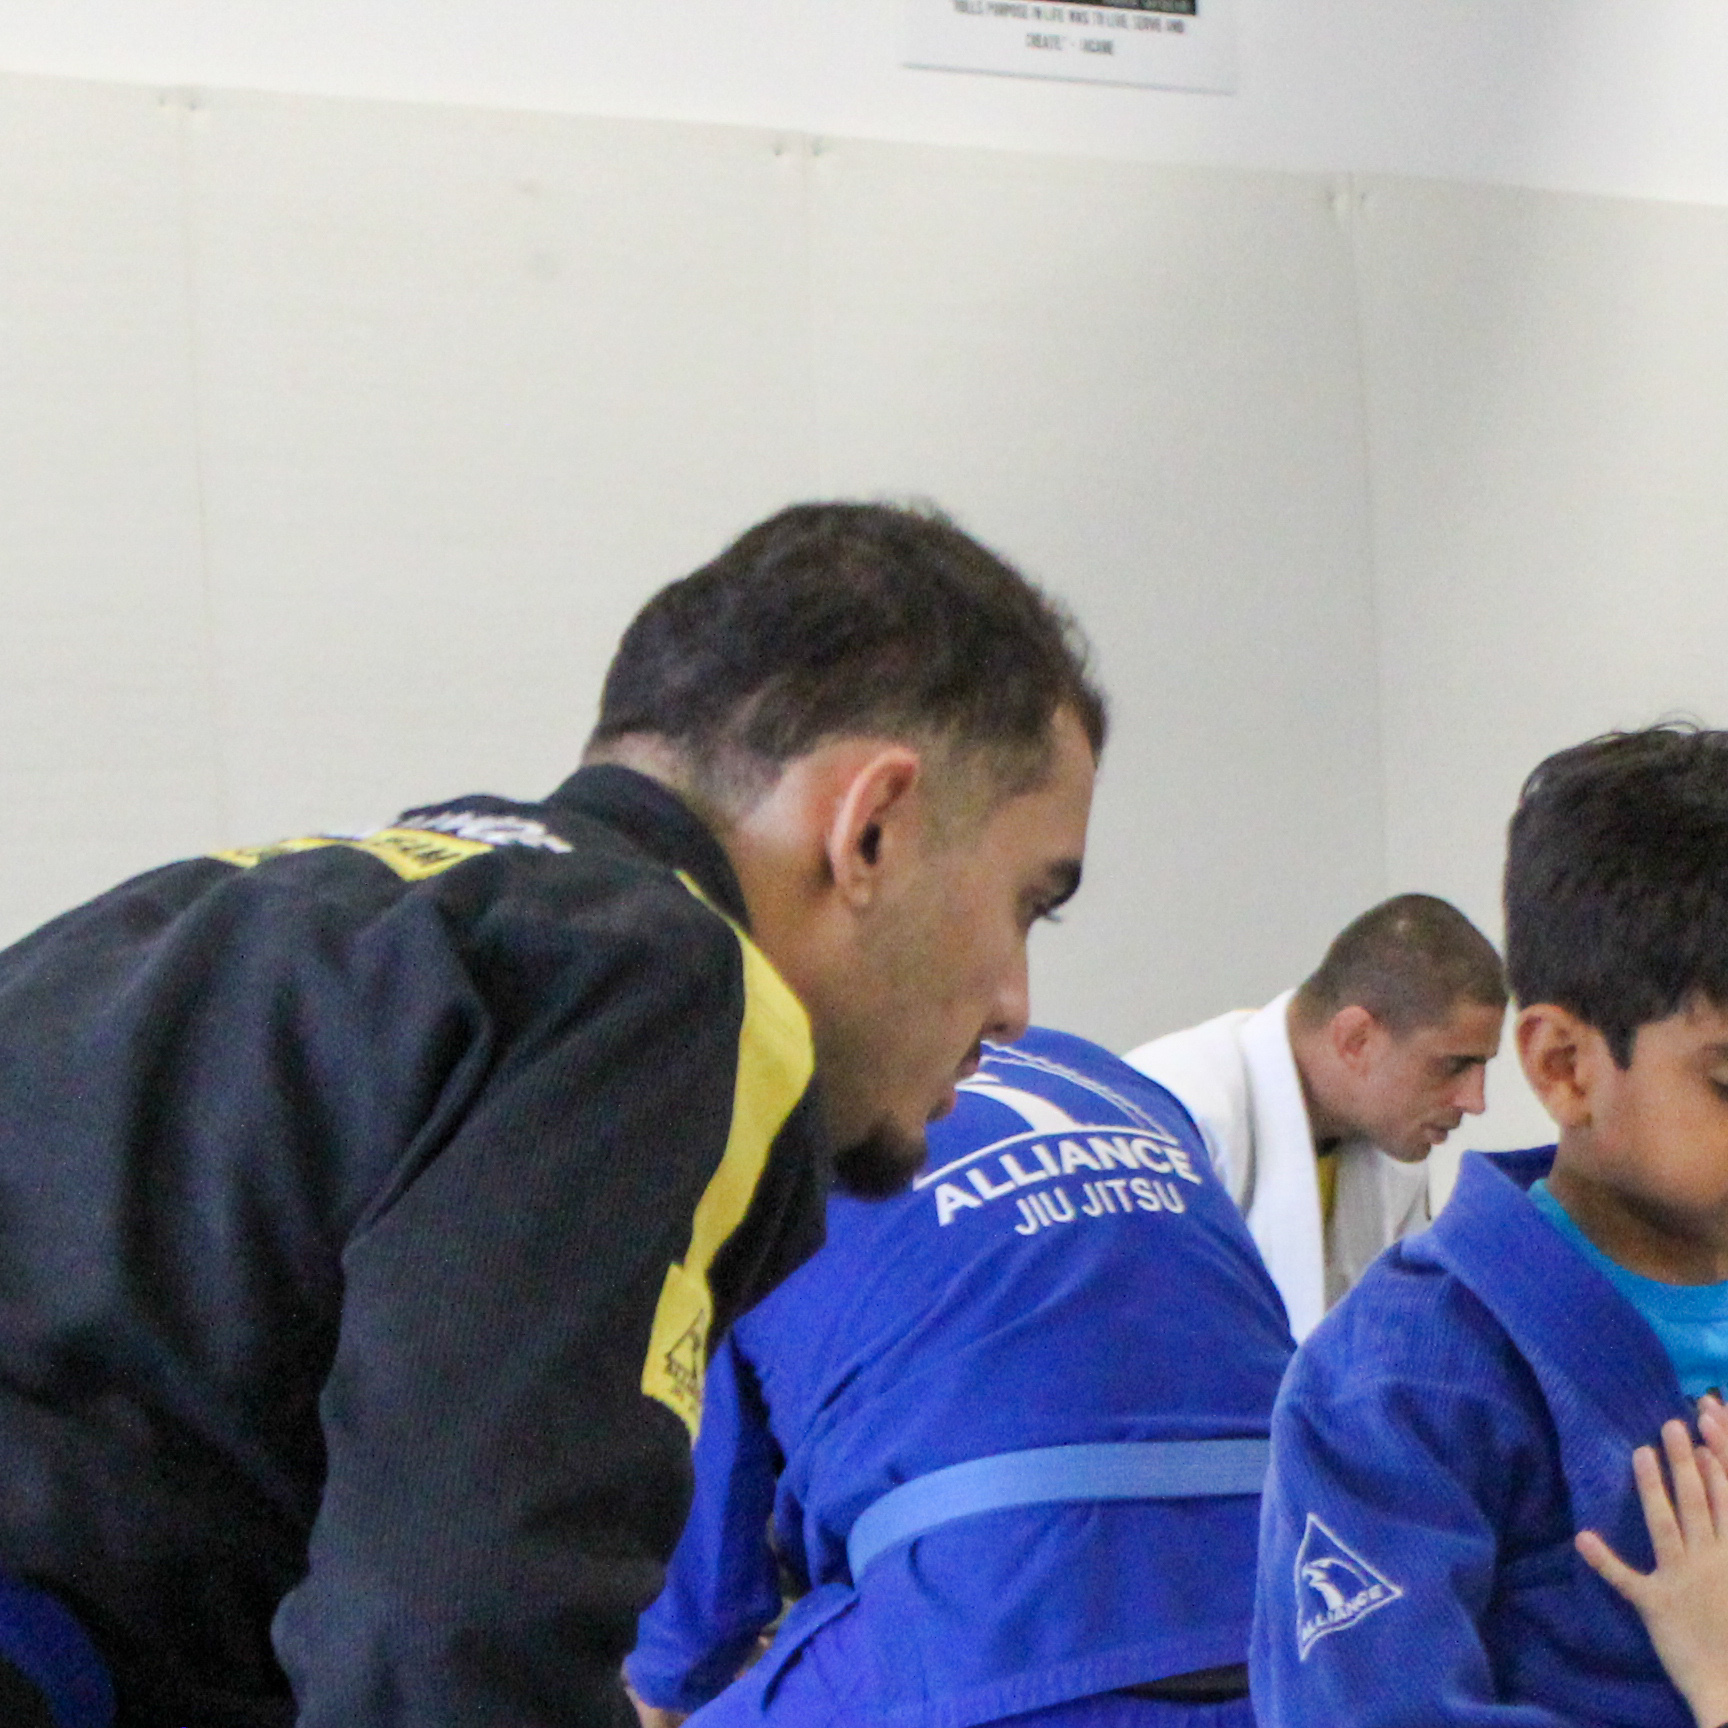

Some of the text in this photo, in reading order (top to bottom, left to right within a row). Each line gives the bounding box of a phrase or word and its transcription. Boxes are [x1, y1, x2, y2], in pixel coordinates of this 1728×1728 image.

[934, 1136, 1202, 1226] ALLIANCE
[1015, 1178, 1186, 1236] JIU JITSU
